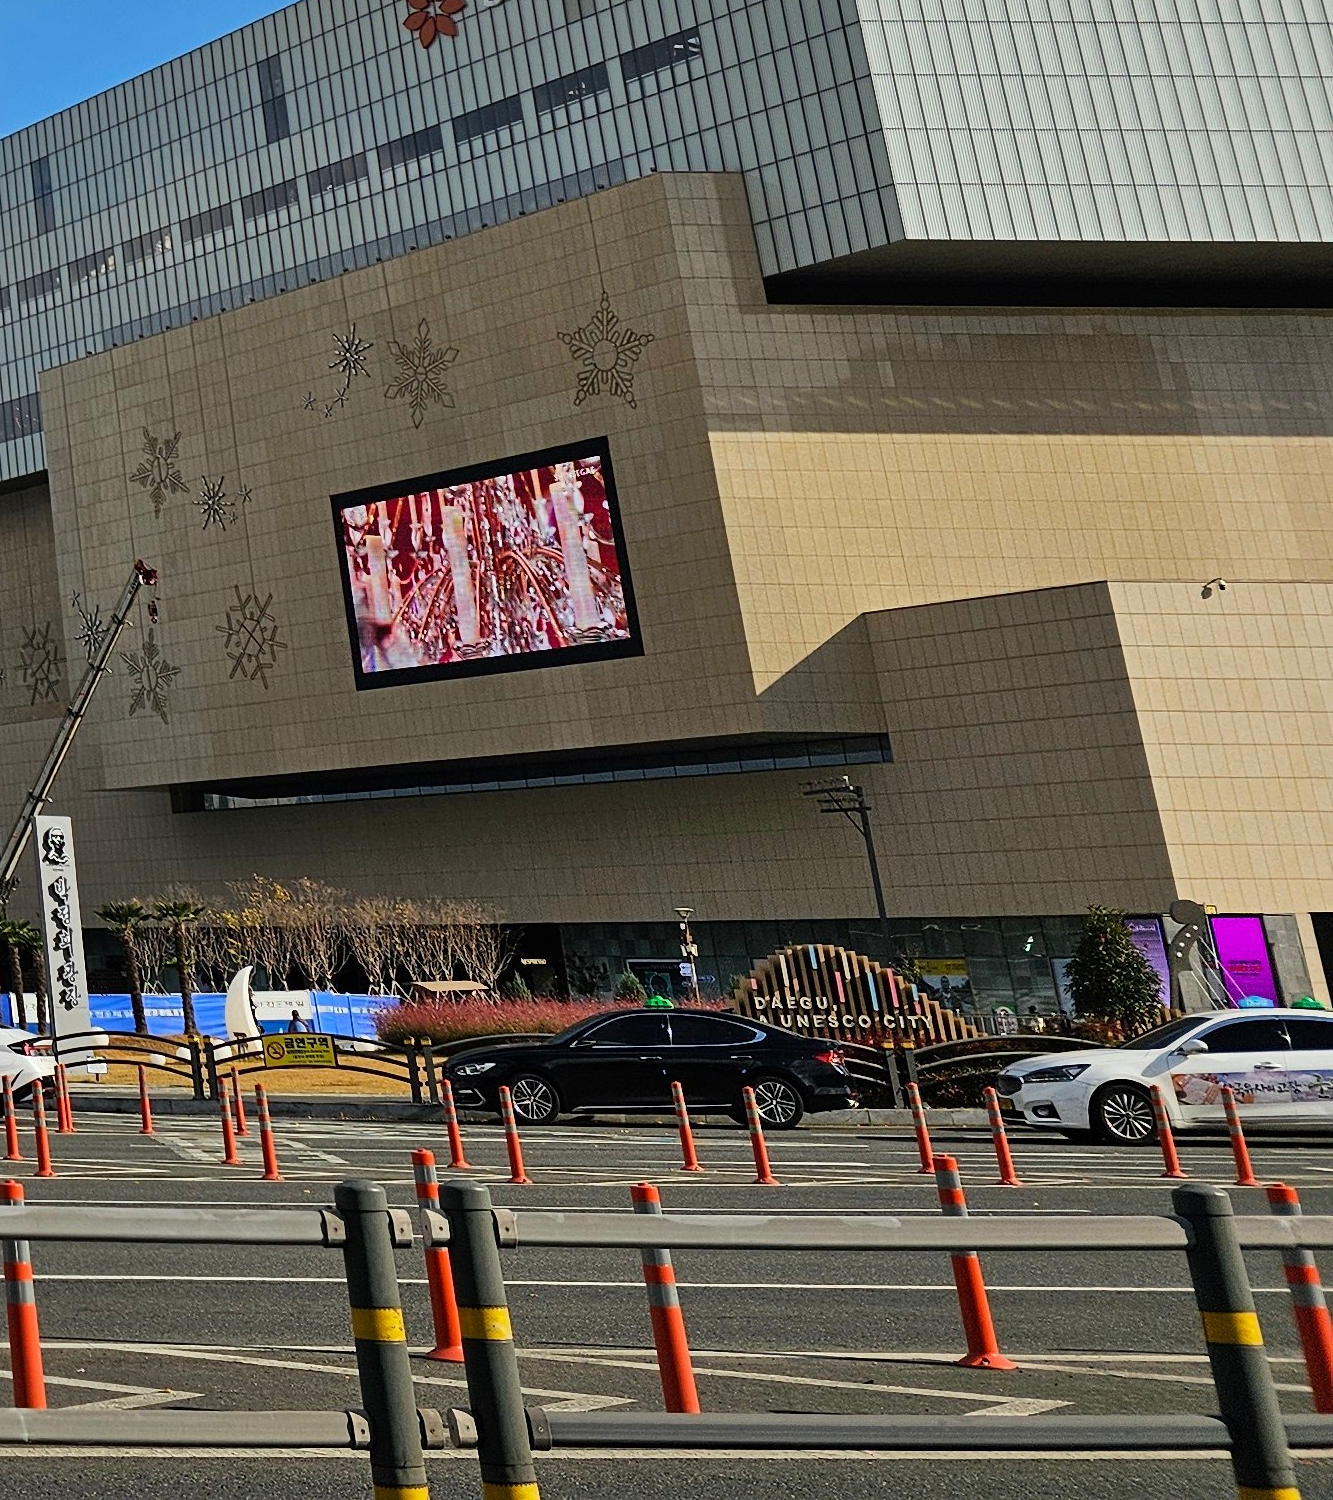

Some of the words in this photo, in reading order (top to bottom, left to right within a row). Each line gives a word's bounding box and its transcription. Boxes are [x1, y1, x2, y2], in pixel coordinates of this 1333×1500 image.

[754, 996, 838, 1011] DAEGU,
[781, 1015, 872, 1028] UNESCO
[883, 1015, 933, 1029] CITY
[284, 1037, 330, 1049] 금연구역
